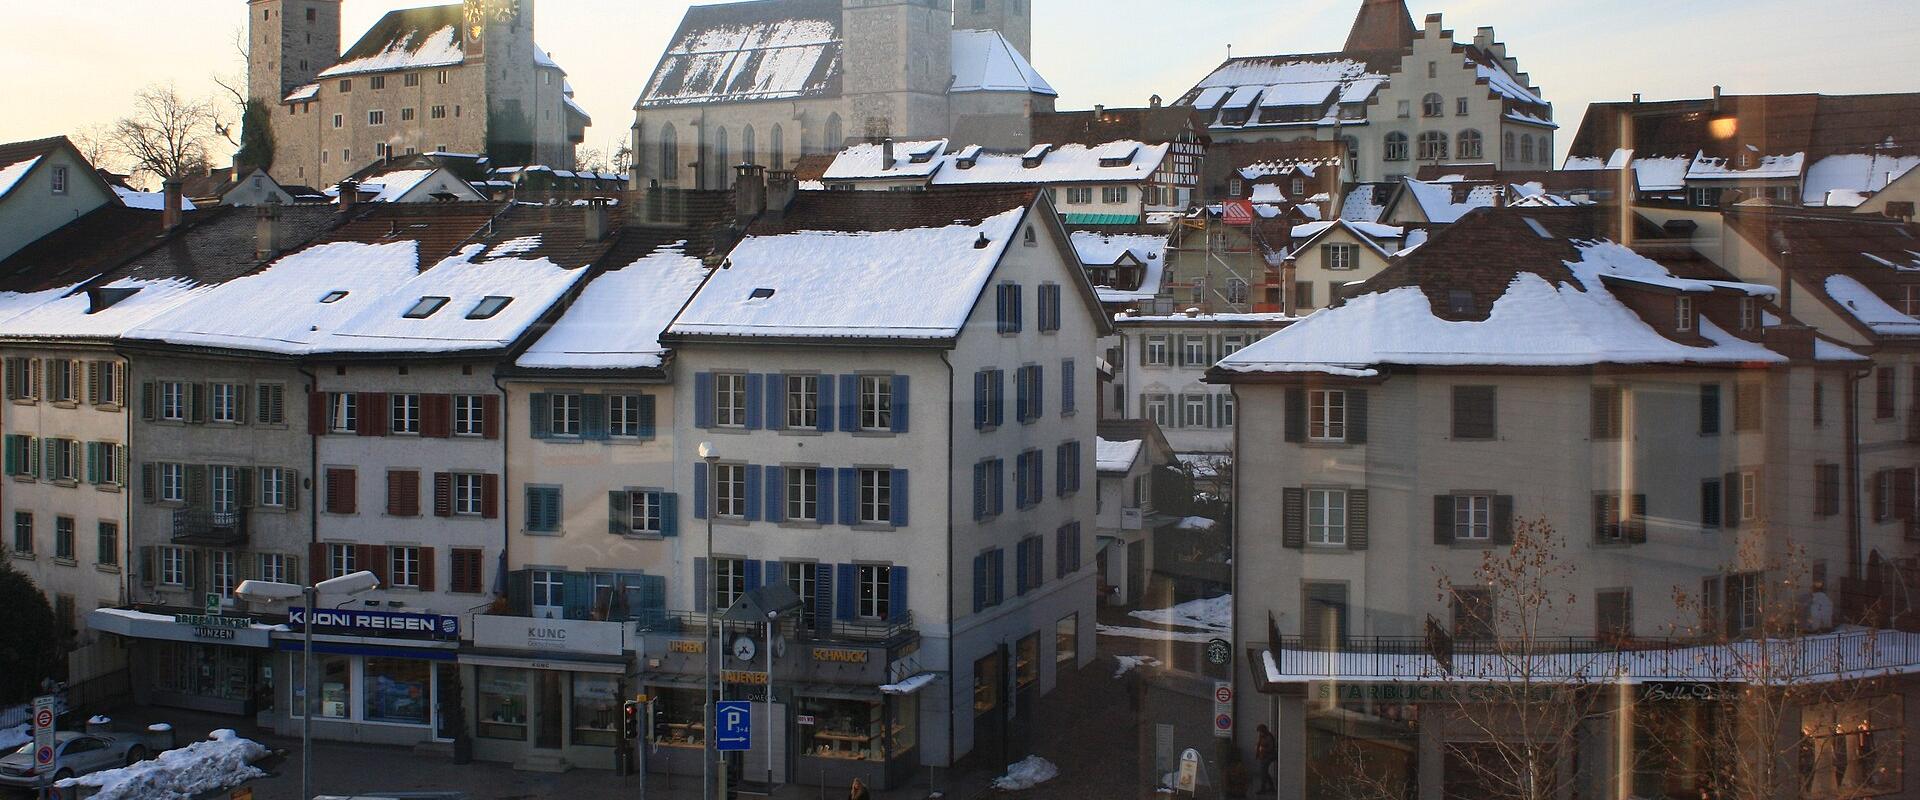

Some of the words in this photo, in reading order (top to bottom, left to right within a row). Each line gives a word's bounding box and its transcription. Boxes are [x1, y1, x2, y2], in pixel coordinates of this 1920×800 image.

[175, 613, 251, 629] BRIEFMARKEN
[289, 611, 351, 627] KUONI
[356, 615, 435, 631] REISEN
[667, 640, 705, 653] UHREN
[813, 648, 867, 664] SCHMUCK
[727, 711, 740, 731] P
